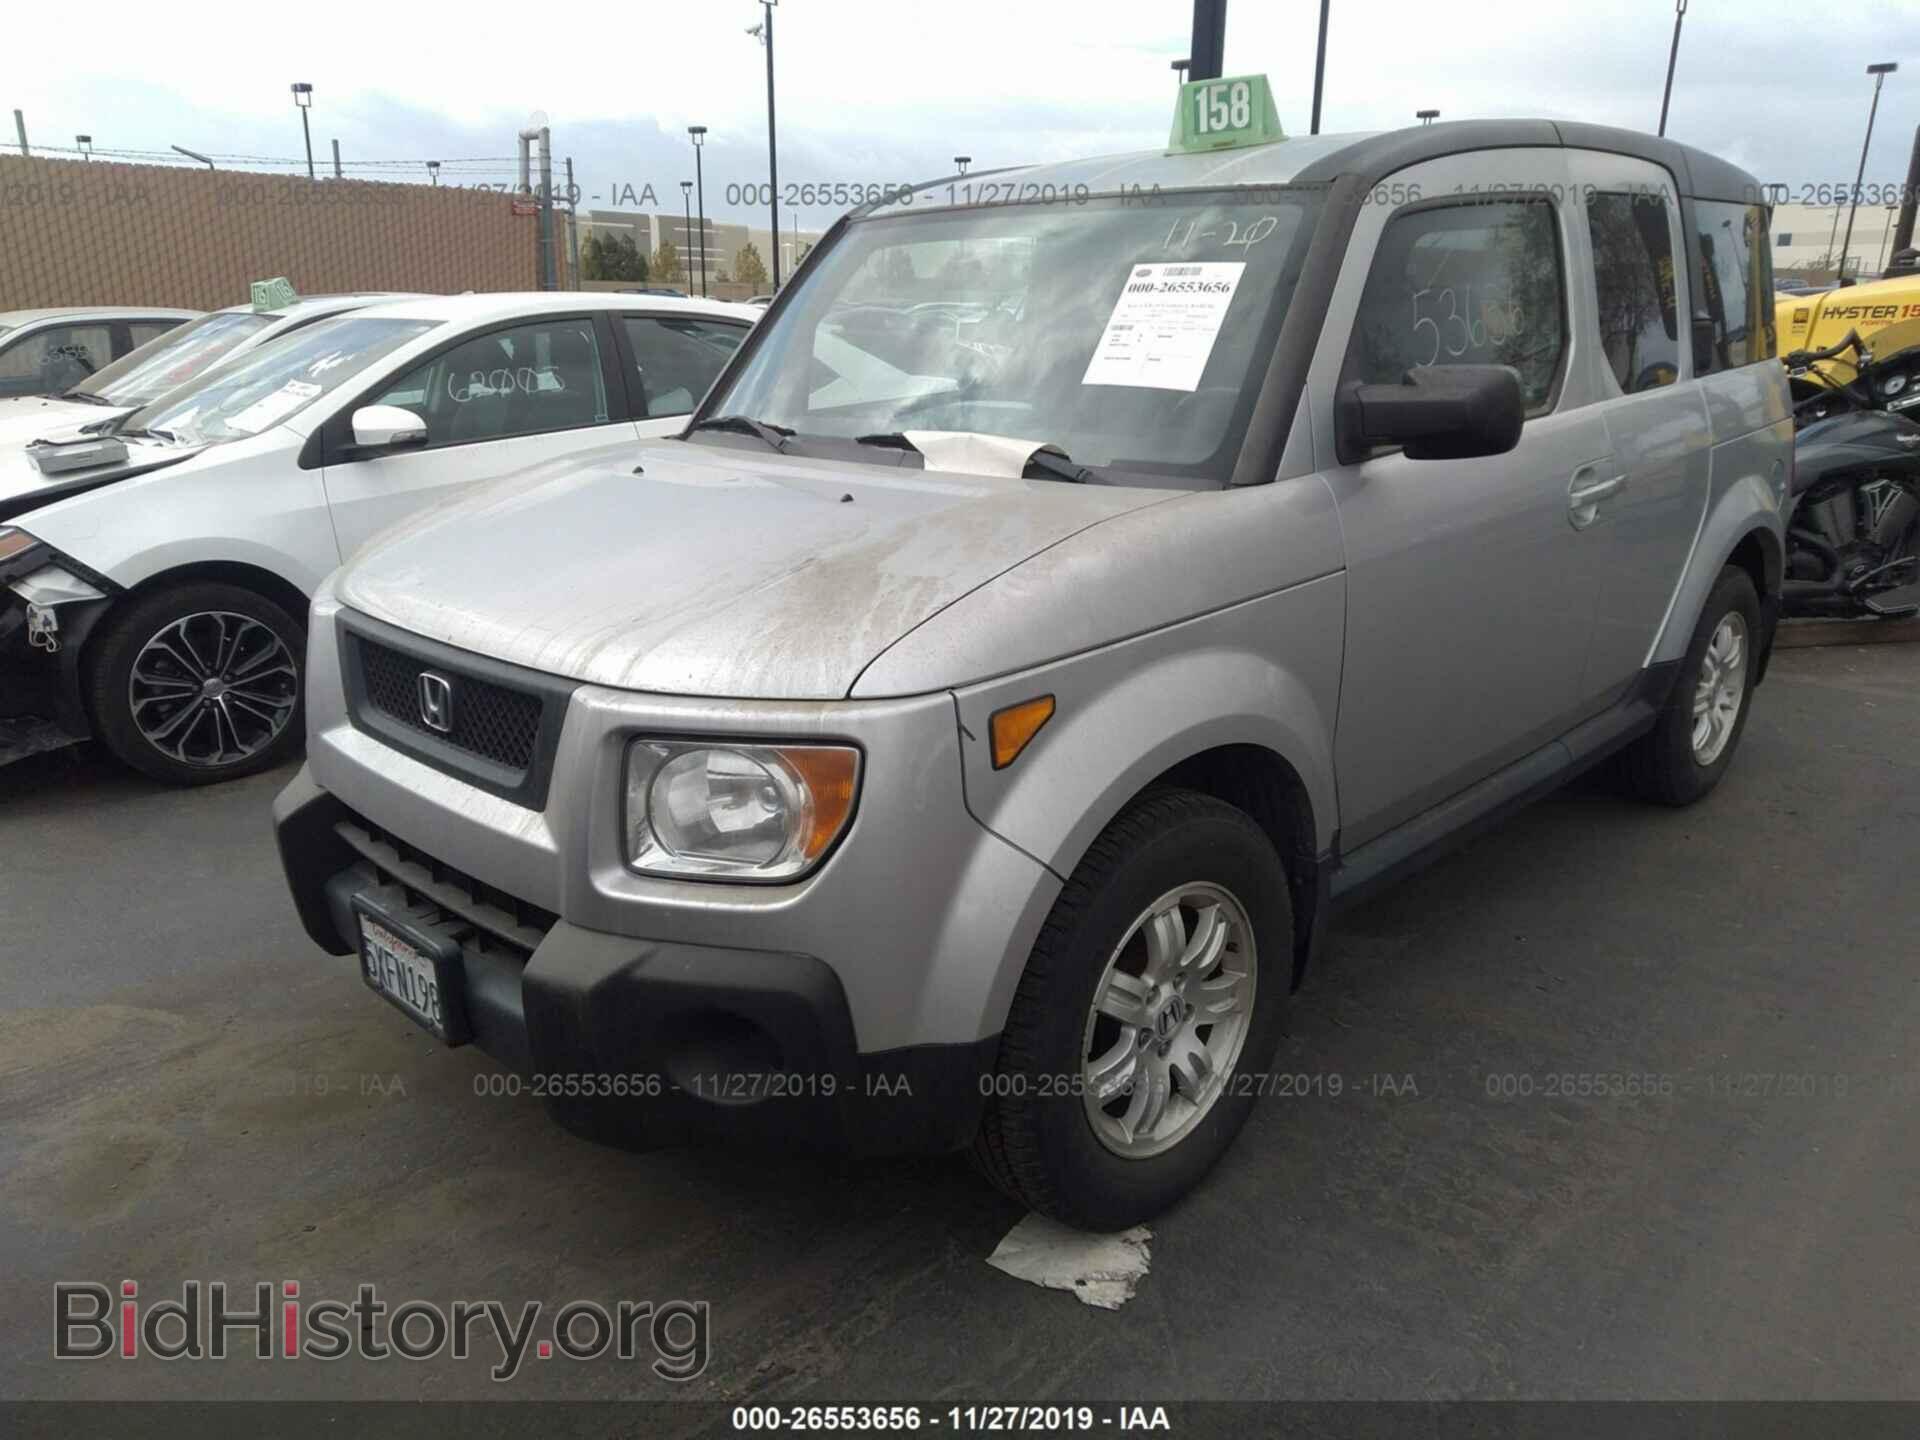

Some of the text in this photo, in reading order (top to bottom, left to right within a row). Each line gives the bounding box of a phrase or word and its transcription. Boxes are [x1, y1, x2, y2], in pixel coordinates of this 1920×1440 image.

[1195, 81, 1250, 133] 158
[1127, 281, 1232, 294] 000-26553656
[1822, 304, 1898, 320] HYSTER
